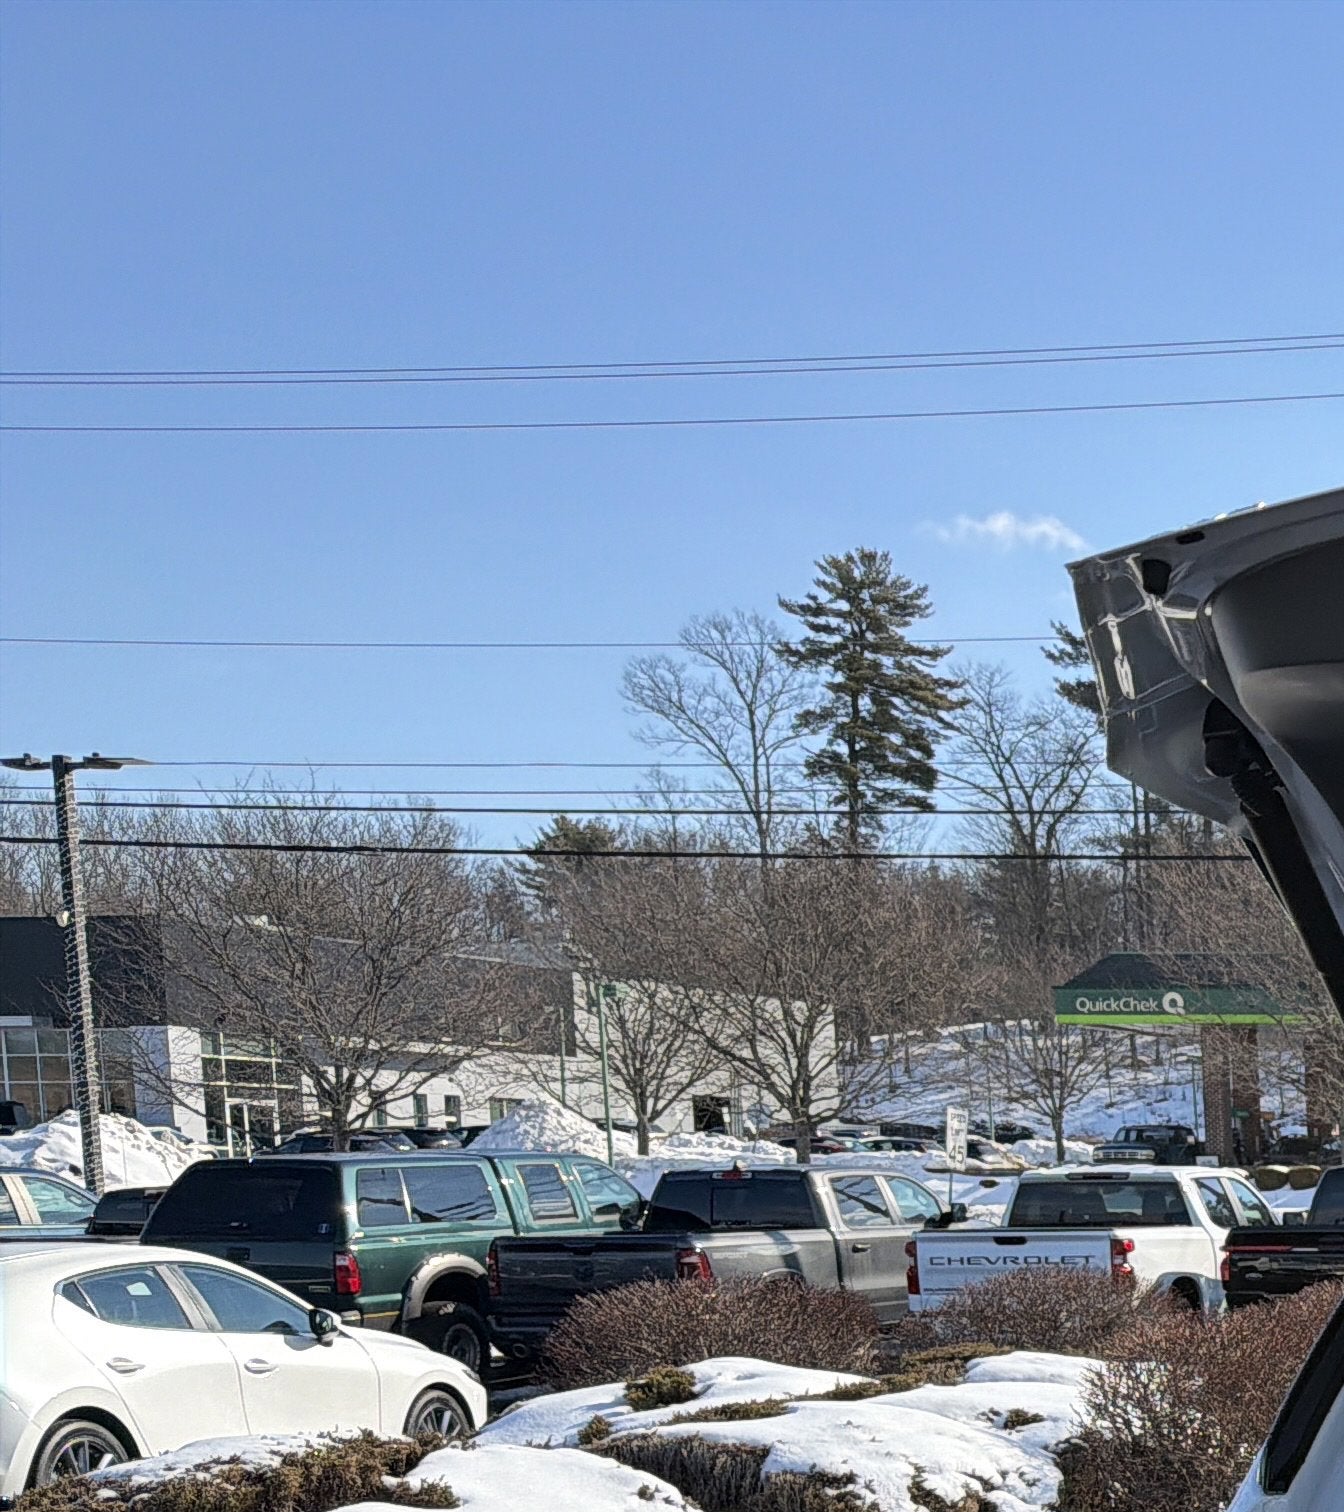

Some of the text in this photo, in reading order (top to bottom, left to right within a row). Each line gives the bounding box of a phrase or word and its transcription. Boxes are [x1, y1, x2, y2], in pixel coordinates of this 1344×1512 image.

[1076, 996, 1158, 1013] QuickChek
[949, 1144, 964, 1164] 45
[929, 1255, 1096, 1266] CHEVROLET
